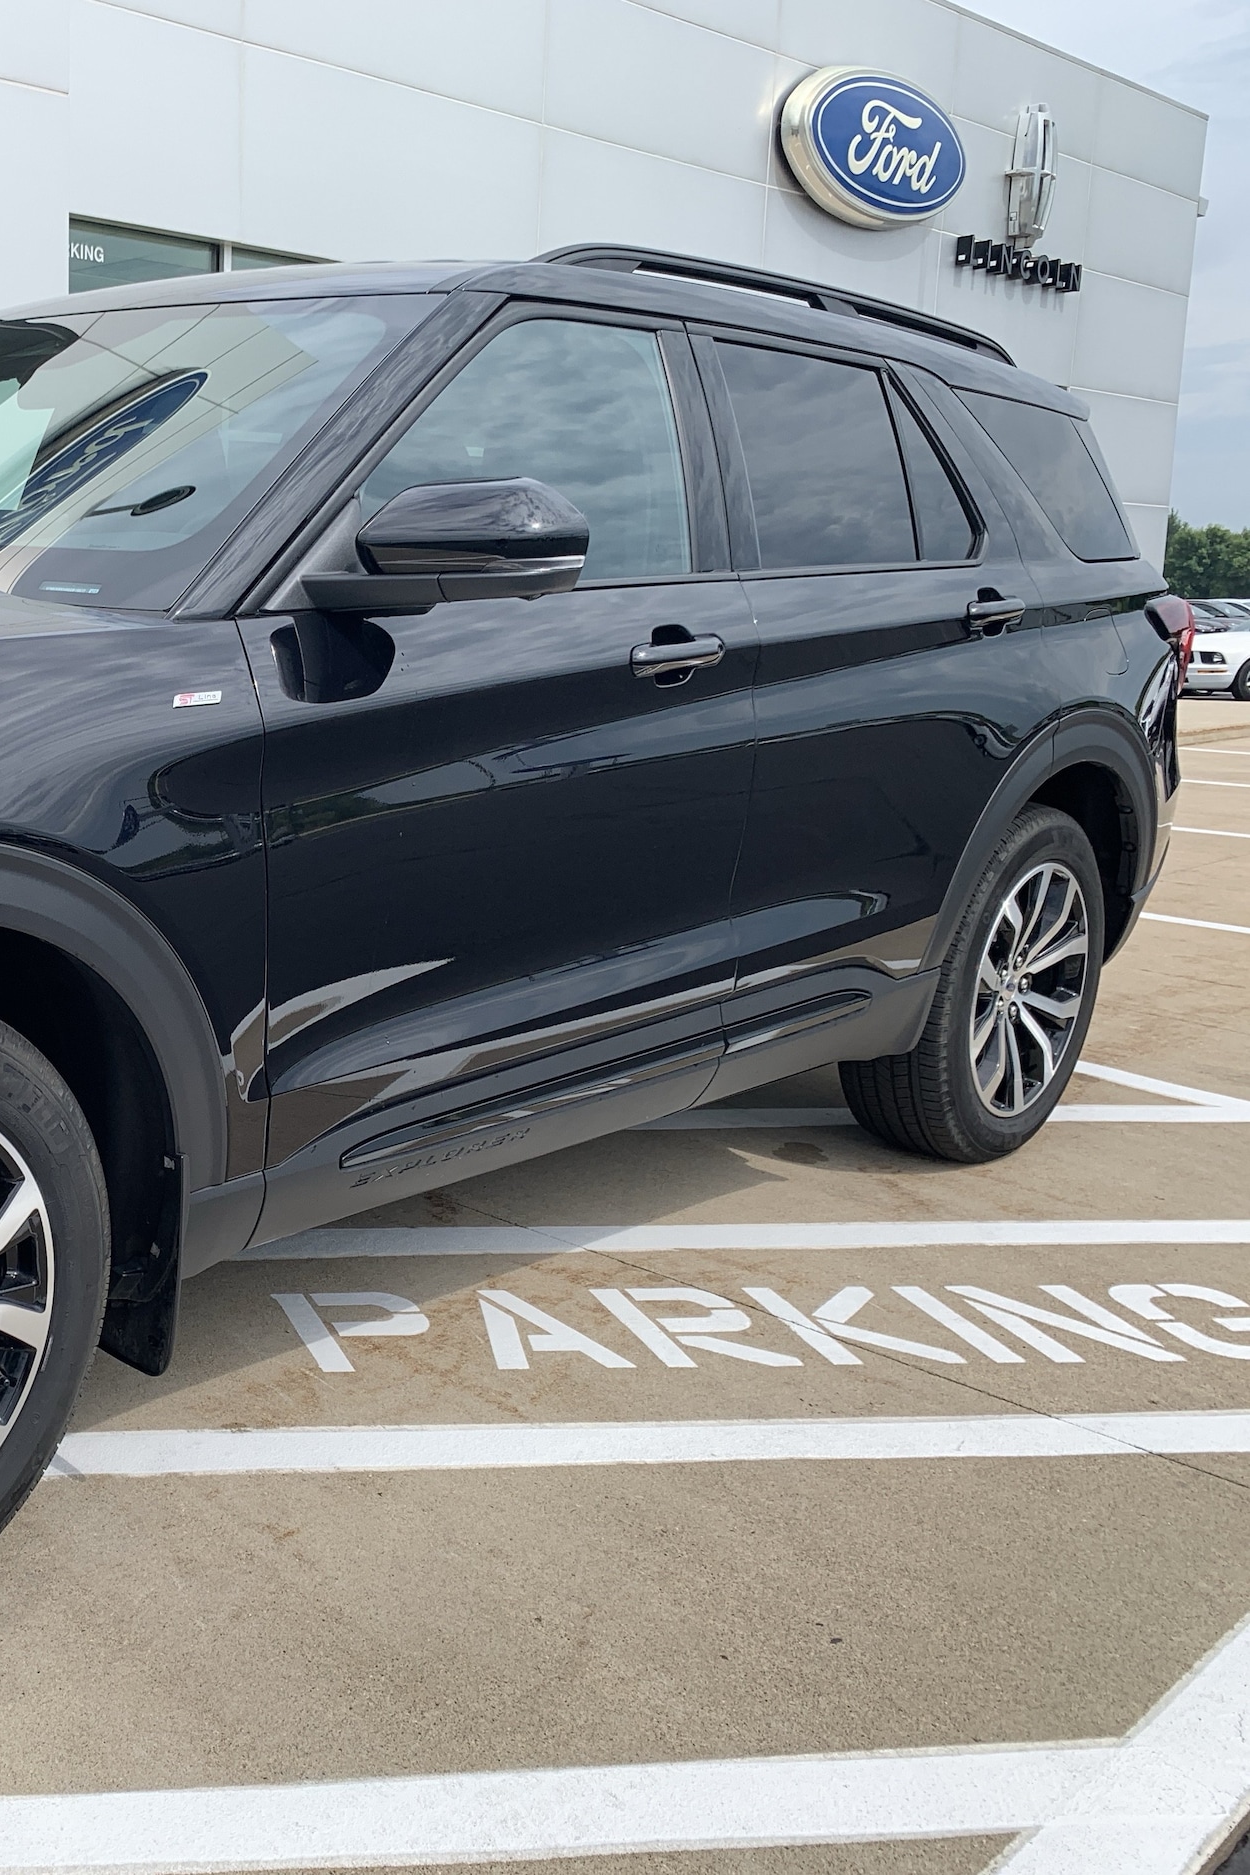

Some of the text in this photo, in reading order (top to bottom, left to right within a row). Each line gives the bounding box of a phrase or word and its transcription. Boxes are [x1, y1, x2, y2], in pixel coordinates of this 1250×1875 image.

[847, 99, 942, 195] Ford
[69, 242, 104, 263] KING
[955, 234, 1083, 293] LINCOLN
[179, 694, 195, 705] ST
[270, 1283, 1250, 1373] PARKING
